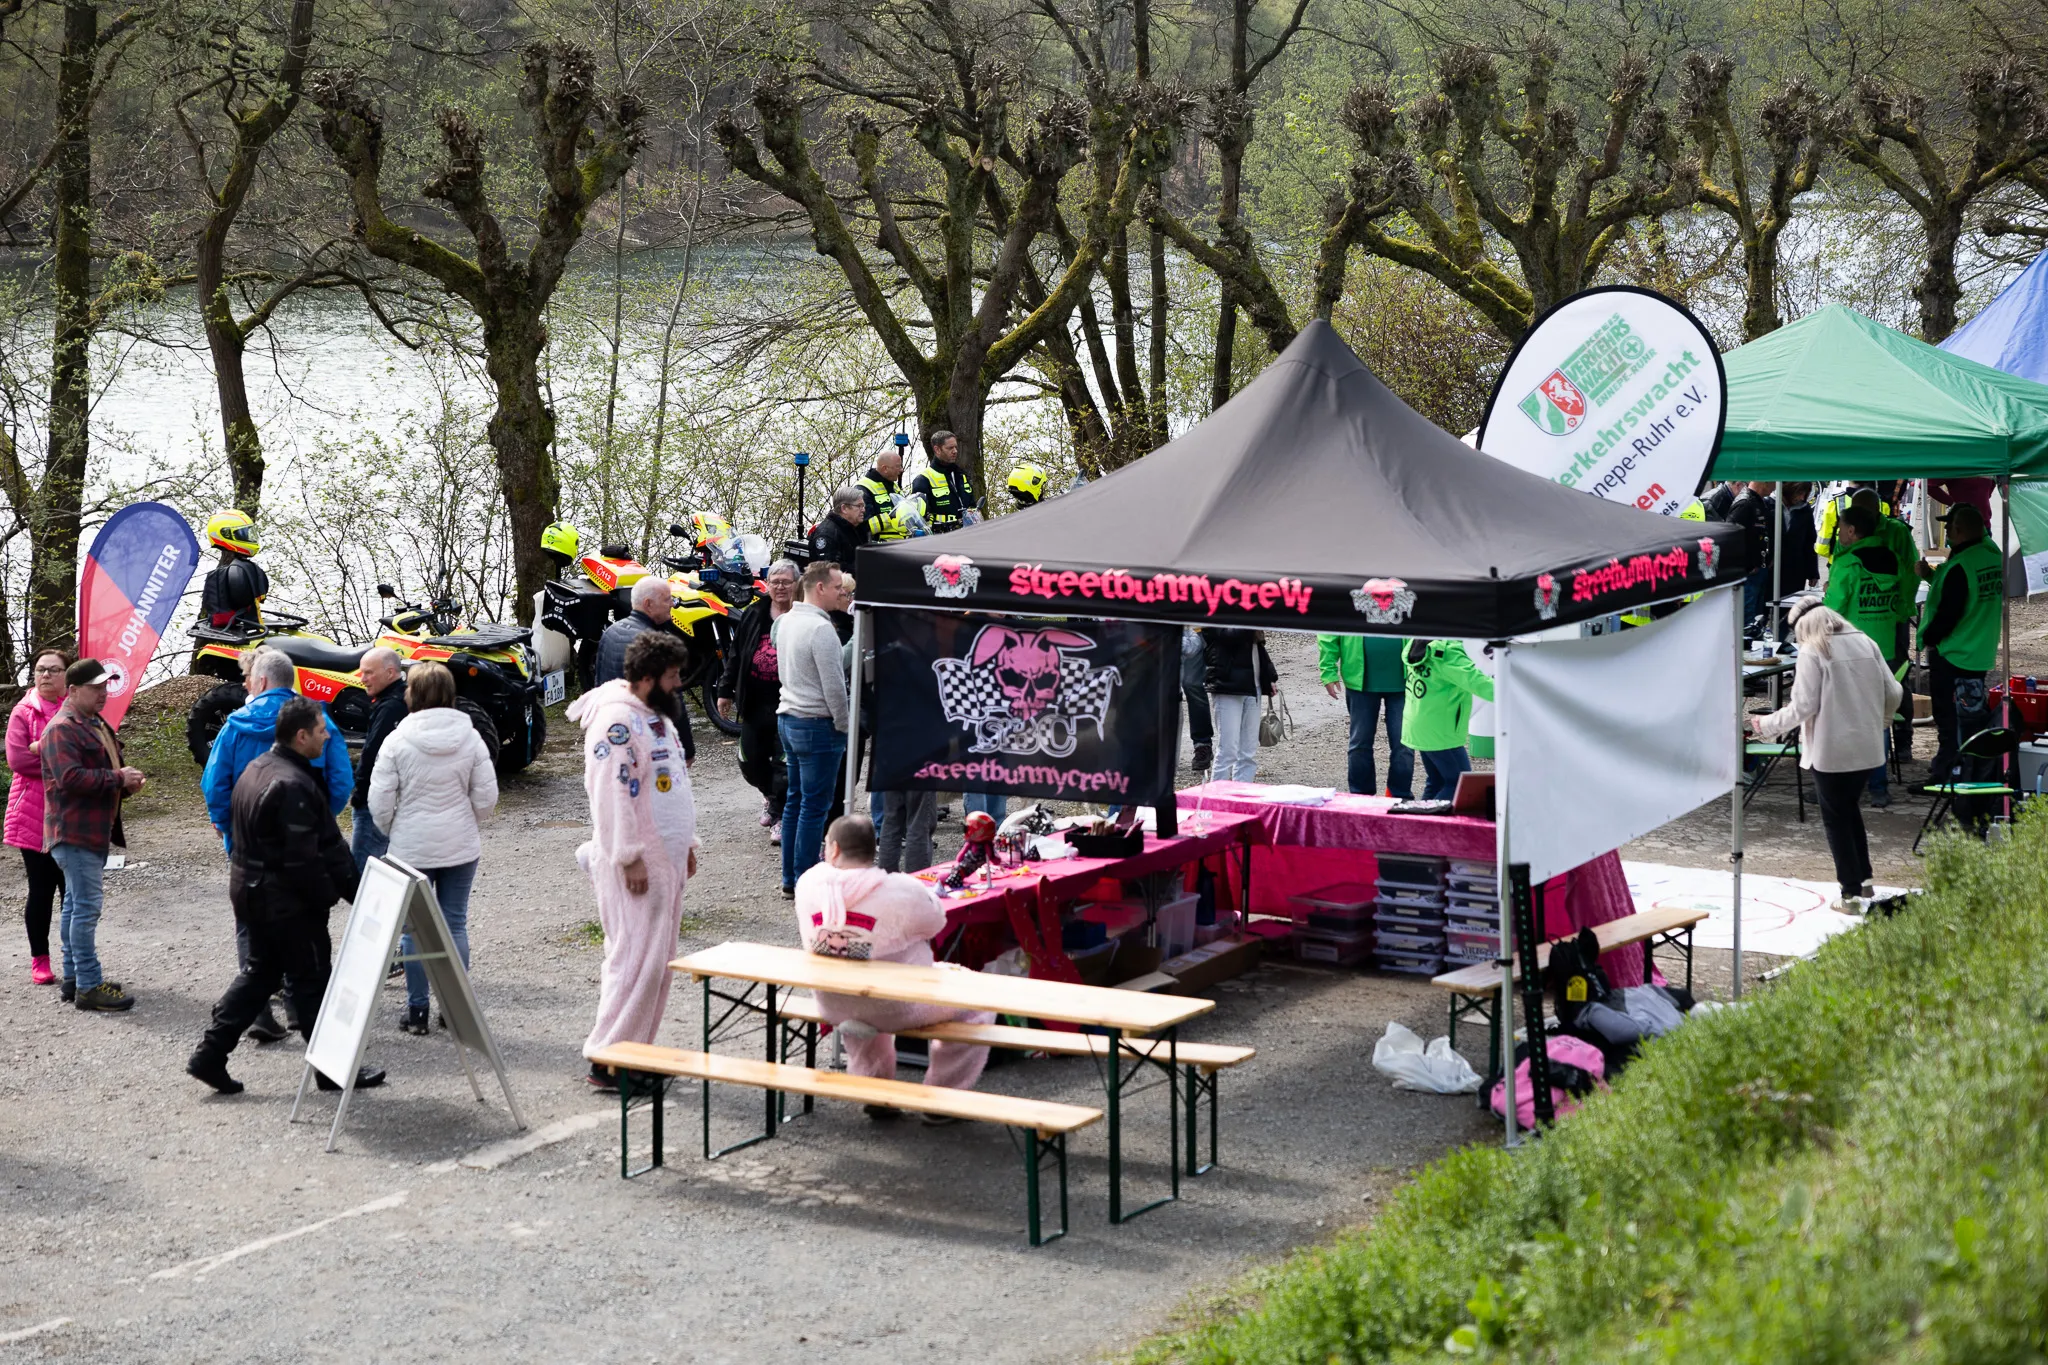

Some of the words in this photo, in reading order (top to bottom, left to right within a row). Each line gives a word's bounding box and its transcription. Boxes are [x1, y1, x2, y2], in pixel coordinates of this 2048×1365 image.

[1565, 318, 1631, 383] VERKEHRS
[1585, 312, 1620, 347] KREIS
[1576, 346, 1623, 394] WACHT
[1595, 347, 1658, 408] ENNEPE-RUHR
[1551, 350, 1701, 488] erkehrswacht
[1588, 415, 1675, 498] nepe-Ruhr
[1631, 483, 1666, 510] en
[1660, 499, 1679, 516] eis
[118, 544, 181, 657] JOHANNITER
[602, 570, 612, 582] 112
[1008, 561, 1313, 617] streetbunnycrew
[316, 683, 332, 695] 112
